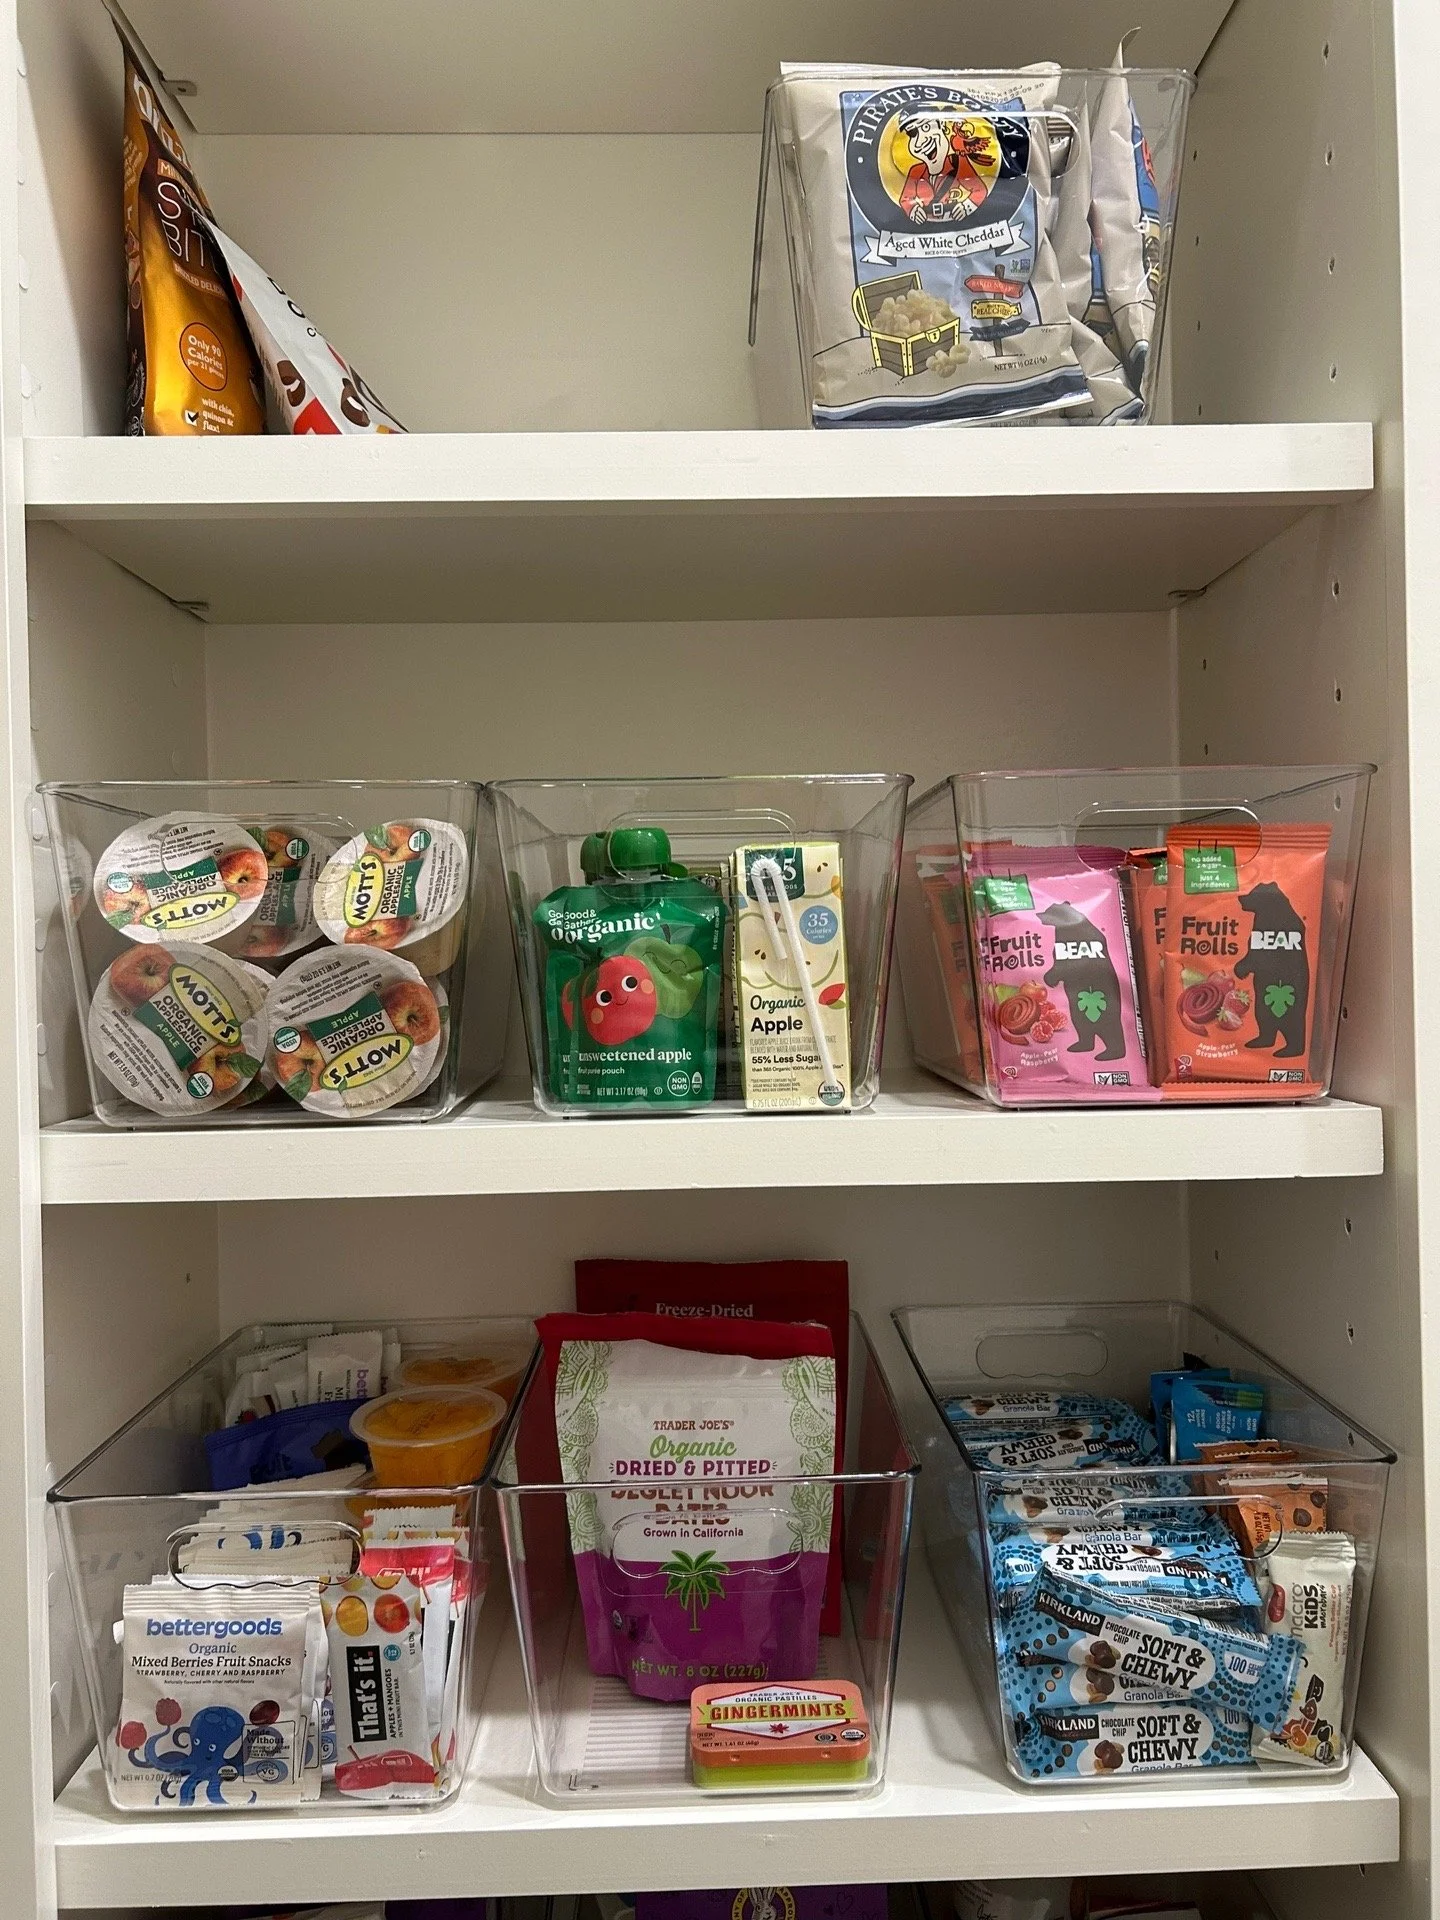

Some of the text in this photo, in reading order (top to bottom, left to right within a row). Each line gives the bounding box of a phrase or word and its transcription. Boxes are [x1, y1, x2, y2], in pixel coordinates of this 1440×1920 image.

[853, 87, 938, 146] PIRATE'S
[885, 227, 1005, 251] Aged White Cheddar
[188, 334, 222, 358] Only 90
[187, 347, 223, 370] Calories
[187, 359, 199, 367] per
[994, 363, 1006, 372] NET
[1007, 362, 1017, 371] WT
[1024, 359, 1034, 368] OZ
[202, 398, 218, 410] with
[202, 410, 226, 425] quinoa
[353, 860, 377, 921] MOTT'S
[381, 868, 397, 914] ORGANIC
[389, 865, 404, 915] APPLESAUCE
[403, 874, 412, 899] APPLE
[152, 896, 228, 926] MOTT'S
[589, 910, 597, 918] &
[808, 912, 829, 928] 35
[1181, 915, 1240, 937] Fruit
[990, 931, 1042, 950] Fruit
[1055, 941, 1106, 960] BEAR
[1180, 937, 1240, 956] Rolls
[1250, 930, 1303, 951] BEAR
[991, 952, 1045, 973] Rolls
[175, 974, 236, 1045] MOTT'S
[750, 994, 806, 1015] Organic
[153, 1000, 201, 1054] APPLESAUCE
[162, 995, 207, 1046] ORGANIC
[320, 1011, 384, 1046] APPLESAUCE
[331, 1009, 360, 1030] APPLE
[751, 1015, 804, 1036] Apple
[156, 1022, 180, 1048] APPLE
[330, 1021, 386, 1055] ORGANIC
[330, 1039, 401, 1085] MOTT'S
[578, 1048, 692, 1065] unsweetened apple
[752, 1056, 771, 1064] 55%
[773, 1055, 794, 1064] Less
[1195, 1048, 1239, 1059] Strawberry
[601, 1066, 625, 1077] pouch
[655, 1302, 754, 1318] Freeze-Dried
[997, 1396, 1051, 1406] CHEWY
[1003, 1404, 1051, 1413] Granola Bar
[653, 1420, 731, 1431] TRADER JOE'S
[649, 1434, 737, 1463] Organic
[1000, 1435, 1057, 1456] CHEWY
[1002, 1446, 1056, 1466] SOFT &
[615, 1459, 771, 1476] DRIED & PITTED
[1262, 1512, 1270, 1523] NET
[643, 1526, 744, 1538] Grown in California
[1085, 1531, 1142, 1543] Granola Bar
[1055, 1556, 1073, 1571] &
[1126, 1563, 1162, 1574] CHOCOLATE
[1037, 1591, 1102, 1627] KIRKLAND
[1320, 1583, 1328, 1629] macrobars
[147, 1618, 282, 1638] bettergoods
[1105, 1621, 1141, 1639] CHOCOLATE
[189, 1643, 237, 1655] Organic
[1113, 1635, 1130, 1645] CHIP
[131, 1655, 292, 1667] Mixed Berries Fruit Snacks
[1137, 1634, 1188, 1667] SOFT
[1186, 1647, 1206, 1669] &
[136, 1669, 188, 1677] STRAWBERRY,
[190, 1669, 221, 1677] CHERRY
[241, 1668, 286, 1676] RASPBERRY
[631, 1659, 653, 1672] NET
[657, 1663, 682, 1677] WT.
[686, 1664, 695, 1677] 8
[699, 1664, 720, 1678] OZ
[1121, 1654, 1198, 1691] CHEWY
[1228, 1656, 1247, 1674] 100
[356, 1650, 381, 1740] That's it.
[384, 1668, 393, 1705] MANGOES
[1124, 1690, 1164, 1702] Granola
[710, 1701, 847, 1721] GINGERMINTS
[1223, 1708, 1240, 1726] 100
[388, 1712, 397, 1739] APPLES
[1101, 1718, 1135, 1728] CHOCOLATE
[1112, 1728, 1127, 1737] CHIP
[1136, 1713, 1202, 1739] SOFT &
[246, 1736, 284, 1744] Without
[1128, 1737, 1199, 1764] CHEWY
